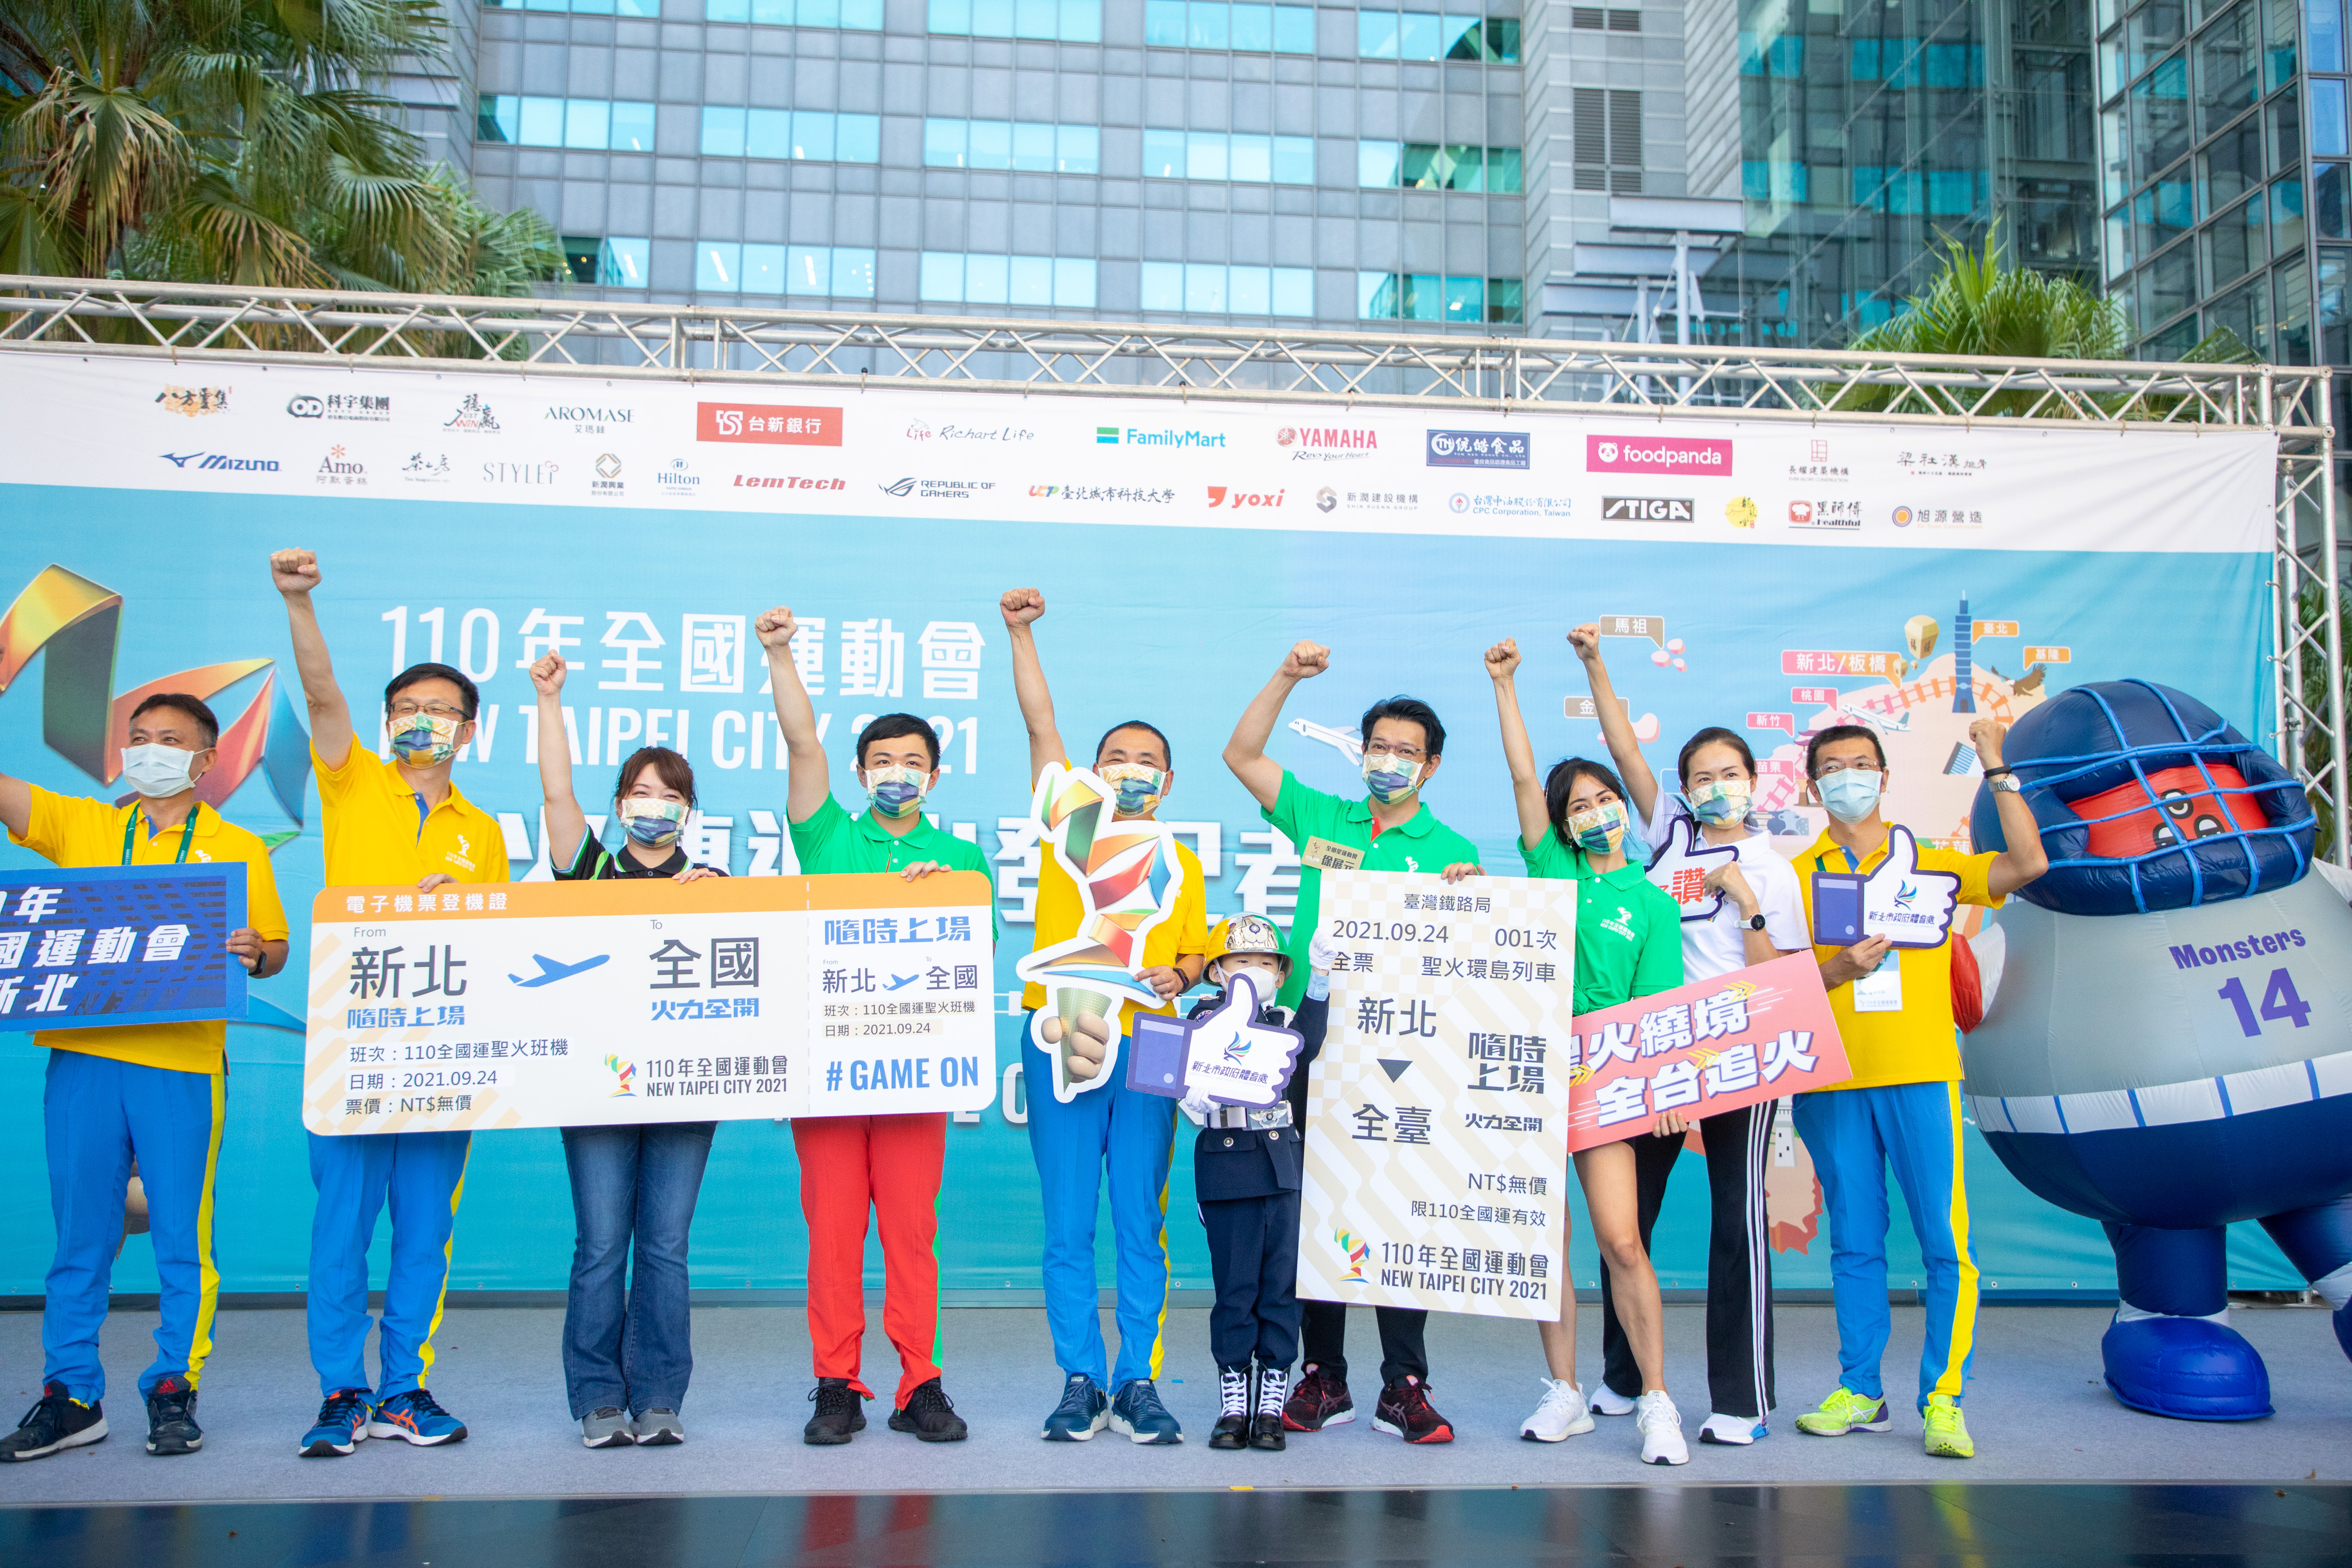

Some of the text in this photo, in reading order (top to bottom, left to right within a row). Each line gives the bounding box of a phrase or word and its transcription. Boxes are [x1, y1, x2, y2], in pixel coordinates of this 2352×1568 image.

[155, 389, 229, 411] 八方雲集
[327, 394, 390, 410] 科宇集團
[544, 406, 635, 423] AROMASE
[574, 424, 606, 435] 艾瑪絲
[748, 416, 822, 435] 台新銀行
[939, 425, 1034, 442] Richart Life
[1127, 428, 1226, 449] FamilyMart
[1299, 428, 1378, 449] YAMAHA
[198, 455, 280, 472] MIZUNO
[319, 455, 363, 474] Amo
[1292, 451, 1322, 460] Revs
[1323, 452, 1344, 461] Your
[1623, 446, 1722, 467] foodpanda
[316, 475, 368, 486] 阿默蛋糕
[657, 473, 700, 485] Hilton
[734, 474, 846, 491] LemTech
[921, 480, 996, 490] REPUBLIC OF
[920, 489, 969, 498] GAMERS
[1061, 483, 1175, 504] 臺北城市科技大學
[1232, 488, 1285, 509] yoxi
[1347, 491, 1419, 503] 新潤建設機構
[1473, 494, 1572, 509] 台灣中油股份有限公司
[1492, 508, 1541, 518] Corporation,
[1606, 500, 1690, 520] STIGA
[1917, 509, 1983, 523] 旭源營造
[1817, 518, 1861, 527] Healthful
[1615, 618, 1647, 634] 馬祖
[1983, 622, 2007, 634] 臺北
[1796, 653, 1887, 674] 新北/板橋
[2035, 649, 2059, 660] 基隆
[1801, 688, 1825, 702] 桃園
[1757, 714, 1781, 727] 新竹
[1757, 761, 1781, 773] 苗栗
[1321, 854, 1355, 870] 徐展元
[1325, 845, 1358, 860] 全明星運動會
[0, 886, 63, 923] 年
[346, 892, 508, 914] 電子機票登機證
[1403, 893, 1491, 913] 臺灣鐵路局
[650, 920, 663, 930] To
[1869, 911, 1935, 924] 新北市政府體育處
[354, 927, 386, 938] From
[824, 916, 971, 946] 隨時上場
[1332, 920, 1557, 950] 2021.09.24 001次
[2168, 928, 2307, 970] Monsters
[350, 944, 468, 999] 新北
[649, 937, 760, 989] 全國
[1331, 952, 1556, 983] 全票 聖火環島列車
[822, 967, 877, 994] 新北
[925, 965, 978, 990] 全國
[651, 998, 760, 1021] 火力全開
[2217, 967, 2312, 1038] 14
[347, 1005, 466, 1029] 隨時上場
[1357, 997, 1437, 1038] 新北
[1571, 989, 1749, 1070] 火繞境
[1468, 1032, 1547, 1064] 隨時
[646, 1055, 788, 1079] 110年全國運動會
[941, 1055, 979, 1087] ON
[1192, 1061, 1268, 1084] 新北市政府體育處
[647, 1078, 788, 1098] NEW TAIPEI CITY 2021
[1467, 1063, 1545, 1094] 上場
[1596, 1029, 1819, 1128] 全台追火
[1352, 1104, 1433, 1145] 全臺
[1465, 1113, 1543, 1133] 火力全開
[1468, 1172, 1548, 1196] NT$無價
[1411, 1201, 1546, 1228] 限110全國運有效
[1382, 1242, 1549, 1279] 110年全國運動會
[1381, 1269, 1547, 1300] NEW TAIPEI CITY 2021
